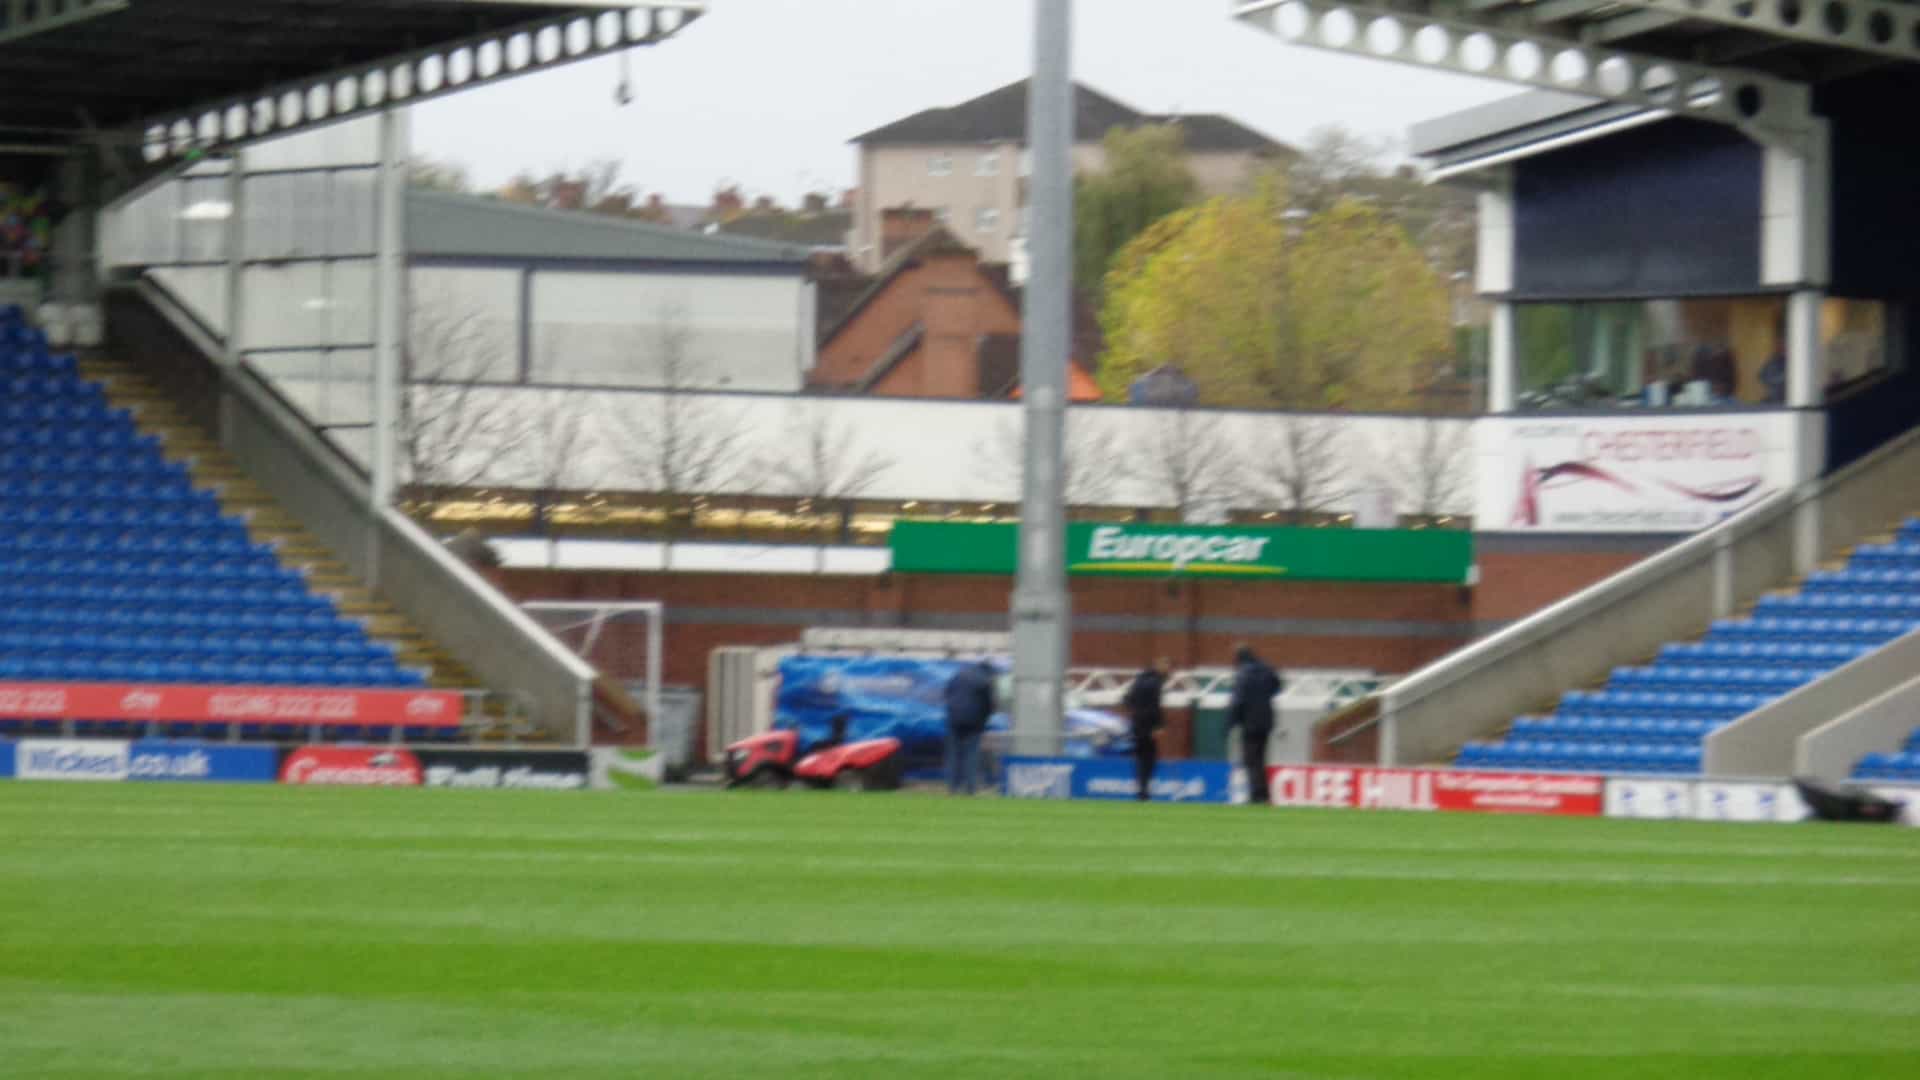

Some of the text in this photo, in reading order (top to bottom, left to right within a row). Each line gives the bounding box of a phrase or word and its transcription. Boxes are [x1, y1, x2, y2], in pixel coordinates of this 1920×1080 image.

[1087, 525, 1272, 571] Europcar
[1271, 767, 1354, 808] CLEE
[1356, 769, 1438, 811] HILL
